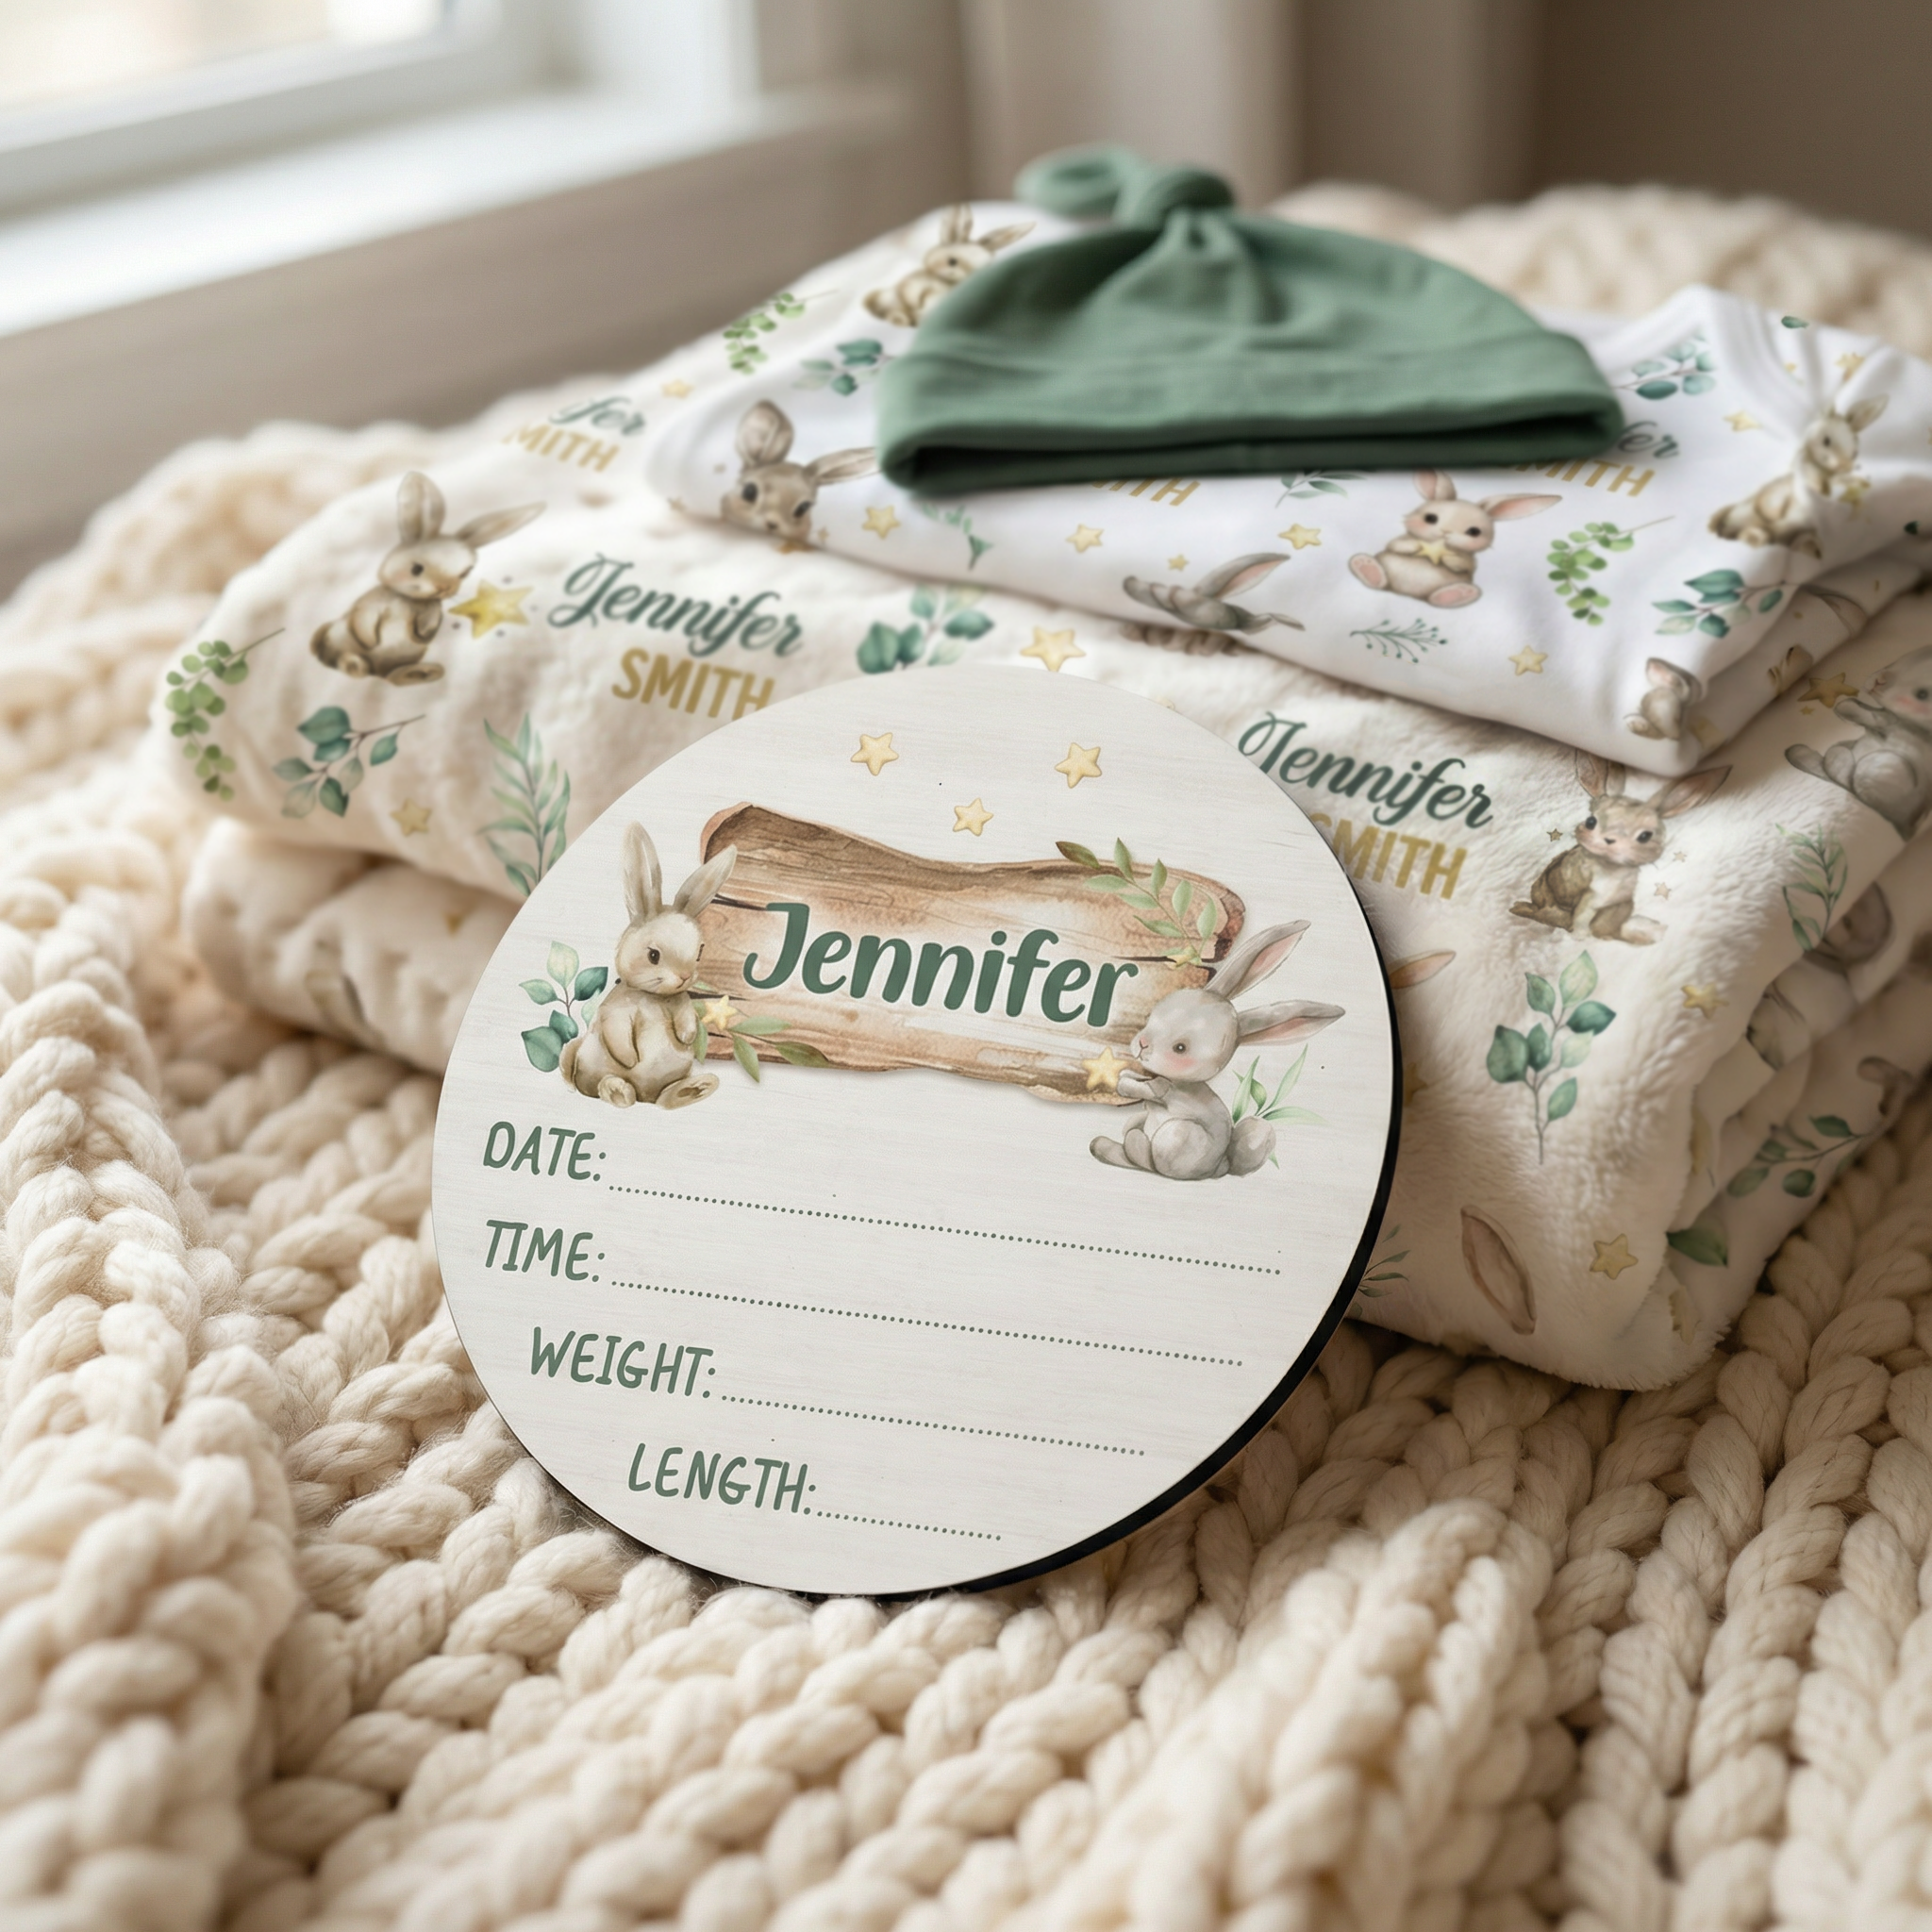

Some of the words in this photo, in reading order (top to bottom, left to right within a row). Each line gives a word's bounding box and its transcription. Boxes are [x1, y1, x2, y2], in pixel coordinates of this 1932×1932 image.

[501, 424, 621, 473] MITH
[546, 552, 804, 658] Jennifer
[611, 647, 775, 722] SMITH
[1237, 711, 1494, 829] Jennifer
[742, 902, 1140, 1027] Jennifer
[482, 1121, 607, 1182] DATE:
[485, 1219, 606, 1283] TIME:
[530, 1325, 716, 1399] WEIGHT:
[627, 1442, 817, 1515] LENGTH:
